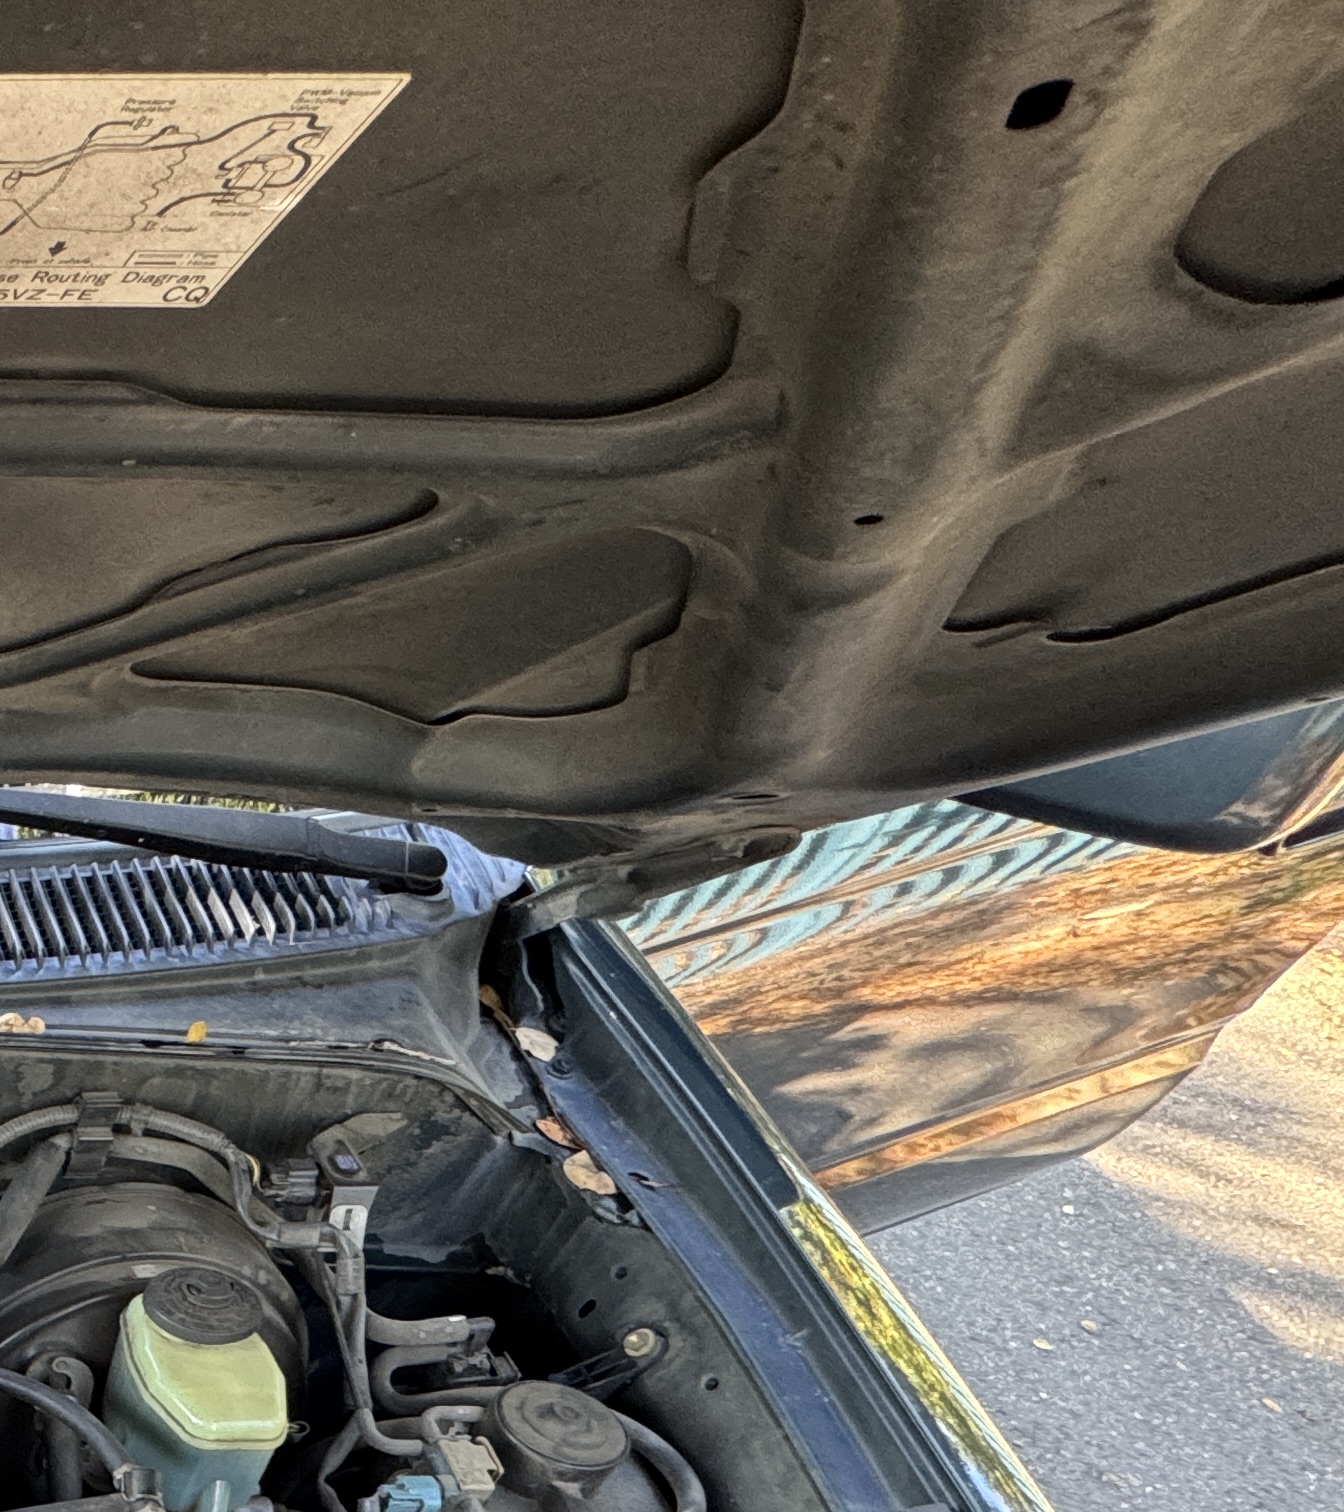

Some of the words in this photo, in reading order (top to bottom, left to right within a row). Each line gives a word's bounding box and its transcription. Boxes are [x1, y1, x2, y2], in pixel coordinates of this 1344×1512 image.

[30, 270, 112, 286] Routing
[120, 270, 207, 286] Diagram
[162, 285, 210, 304] CQ
